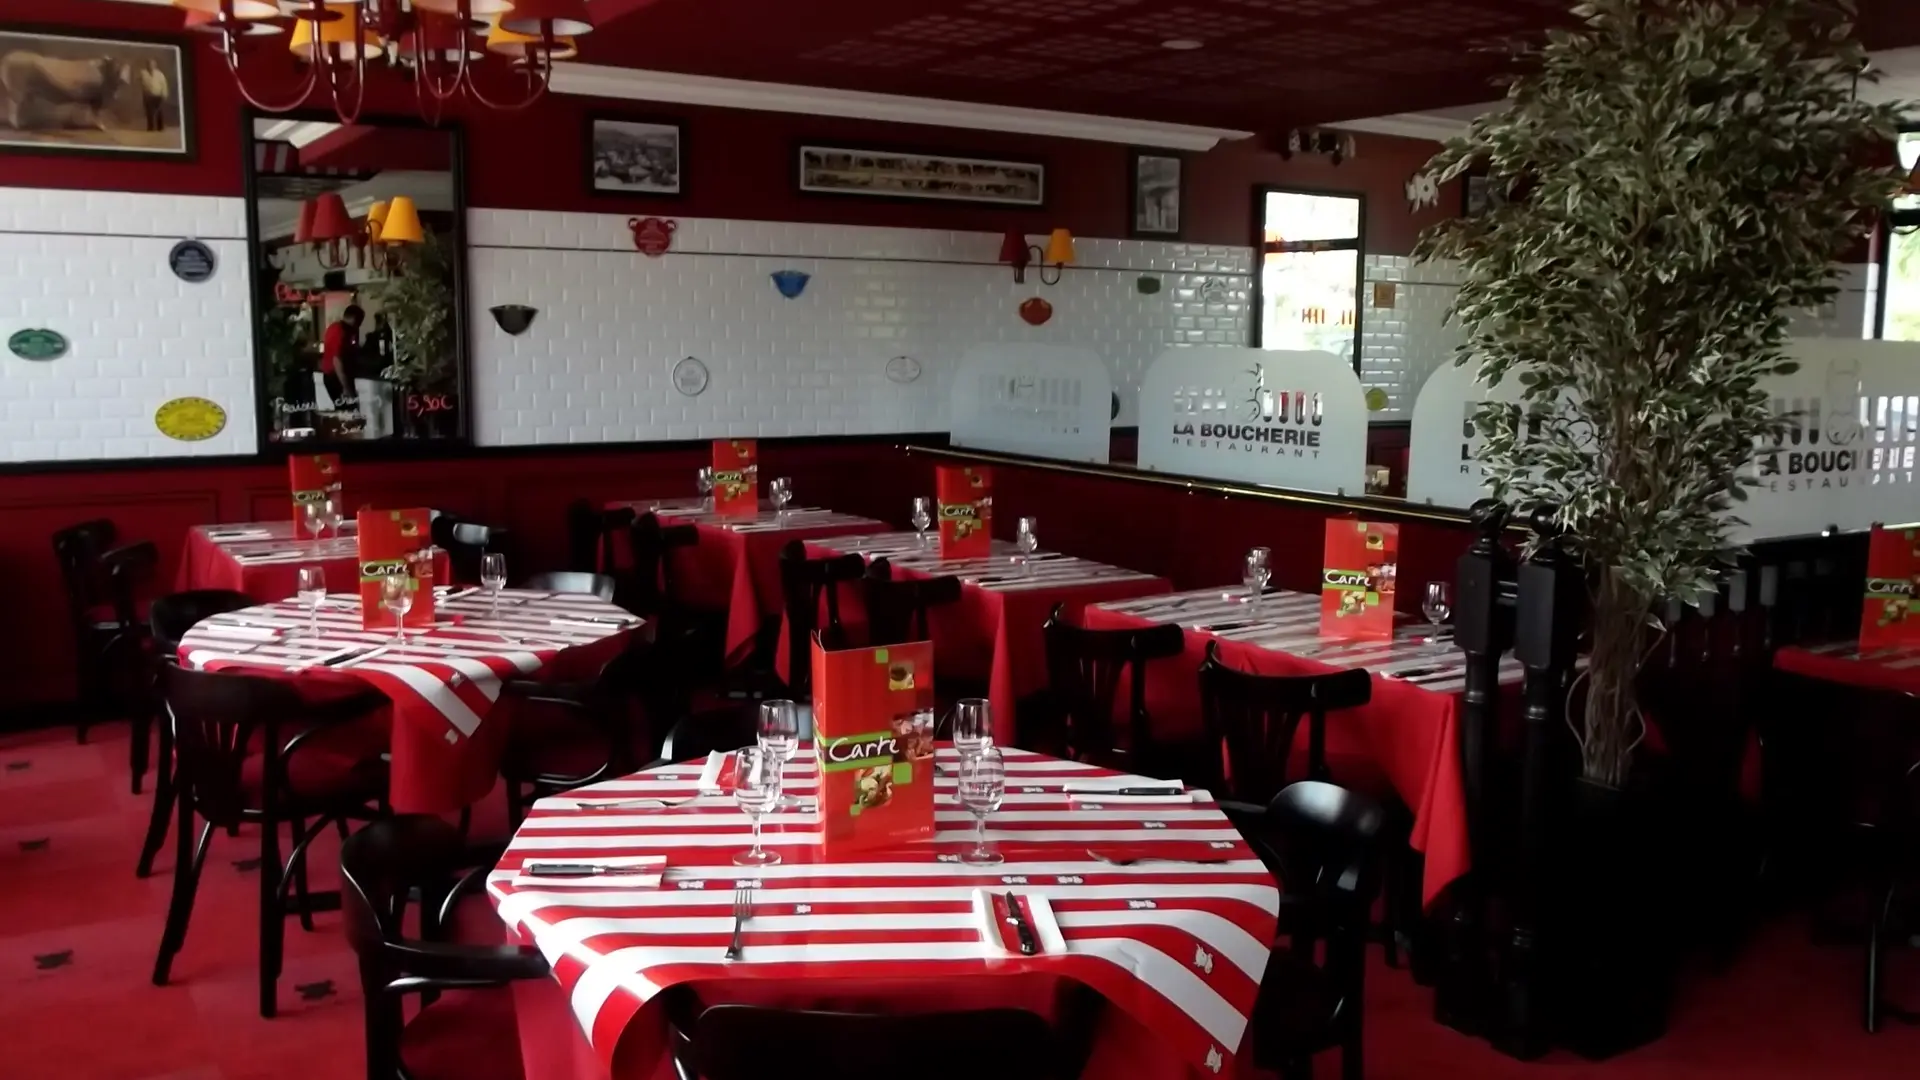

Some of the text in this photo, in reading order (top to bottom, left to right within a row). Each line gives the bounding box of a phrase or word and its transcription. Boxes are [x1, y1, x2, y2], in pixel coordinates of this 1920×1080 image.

[1173, 421, 1321, 447] LA BOUCHERIE
[1172, 437, 1320, 460] RESTAURANT
[944, 504, 976, 517] Carte
[362, 561, 408, 576] Carte
[1325, 569, 1371, 587] Carte
[1867, 577, 1915, 595] Carte
[828, 735, 900, 762] Carte
